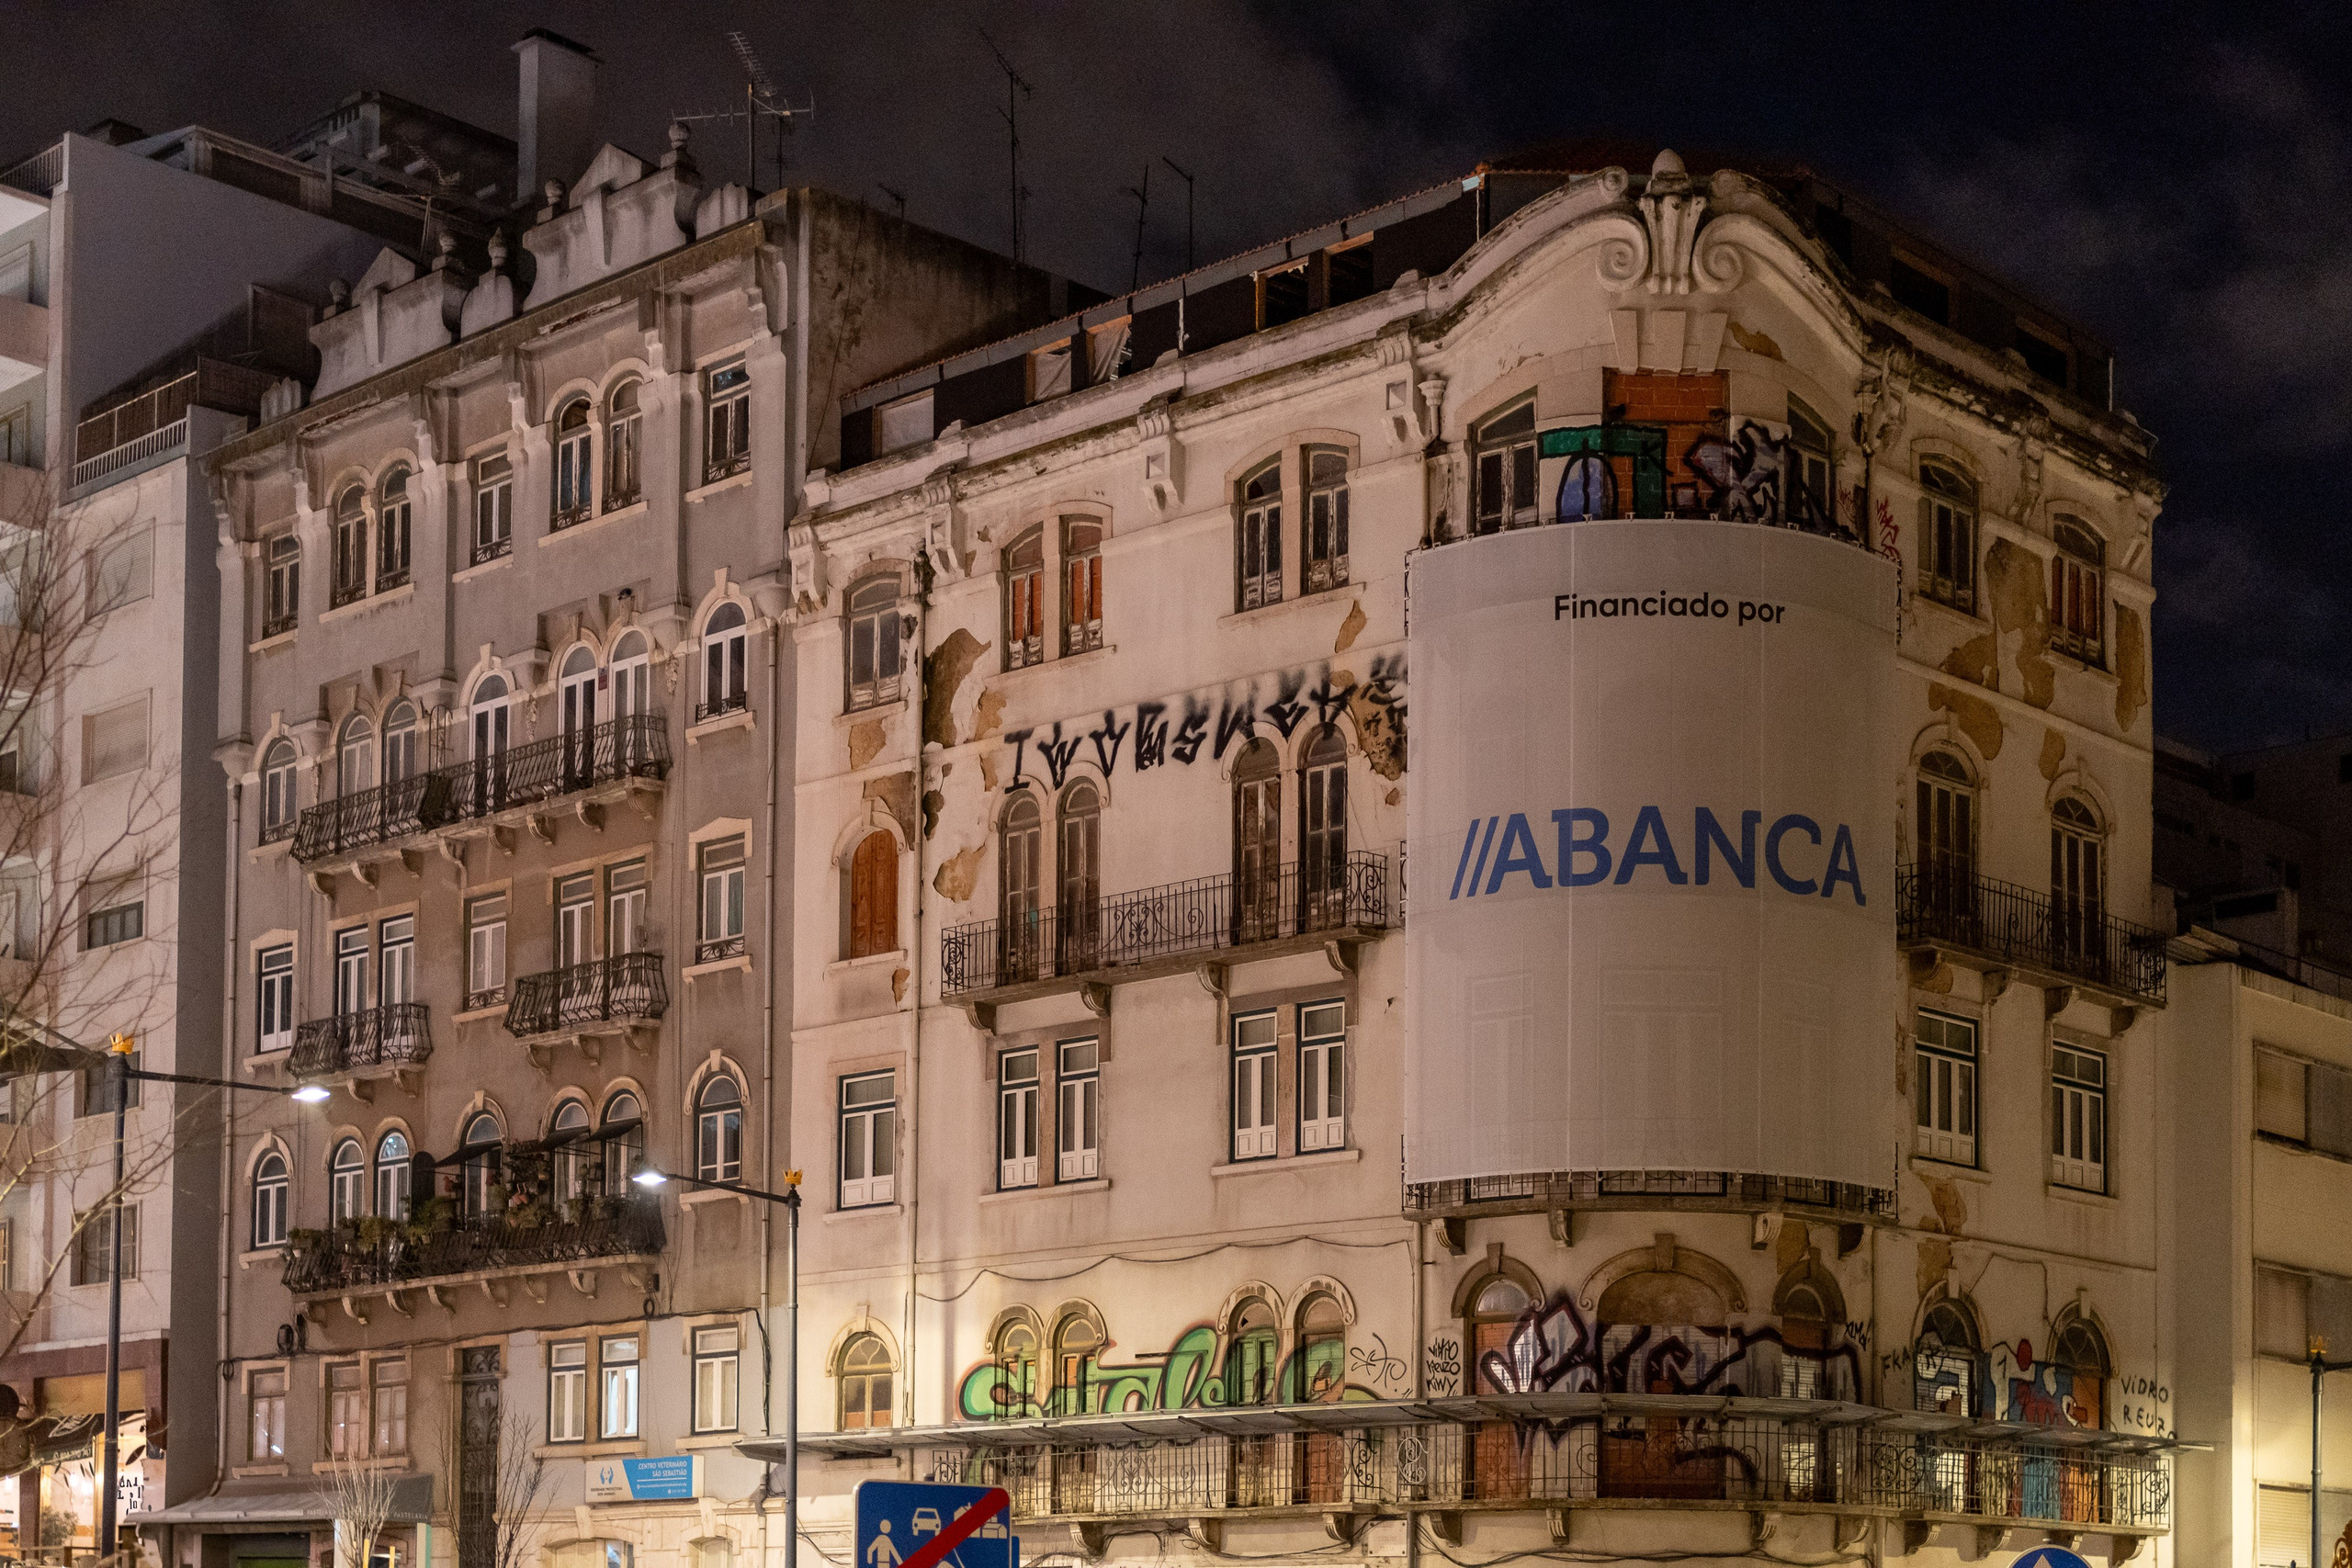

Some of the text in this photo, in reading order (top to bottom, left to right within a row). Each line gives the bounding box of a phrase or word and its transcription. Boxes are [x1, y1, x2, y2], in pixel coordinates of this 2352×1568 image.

[1555, 590, 1785, 626] Financiado por
[657, 1461, 687, 1469] VETERINÁRIO
[662, 1468, 687, 1477] SEBASTIÃO
